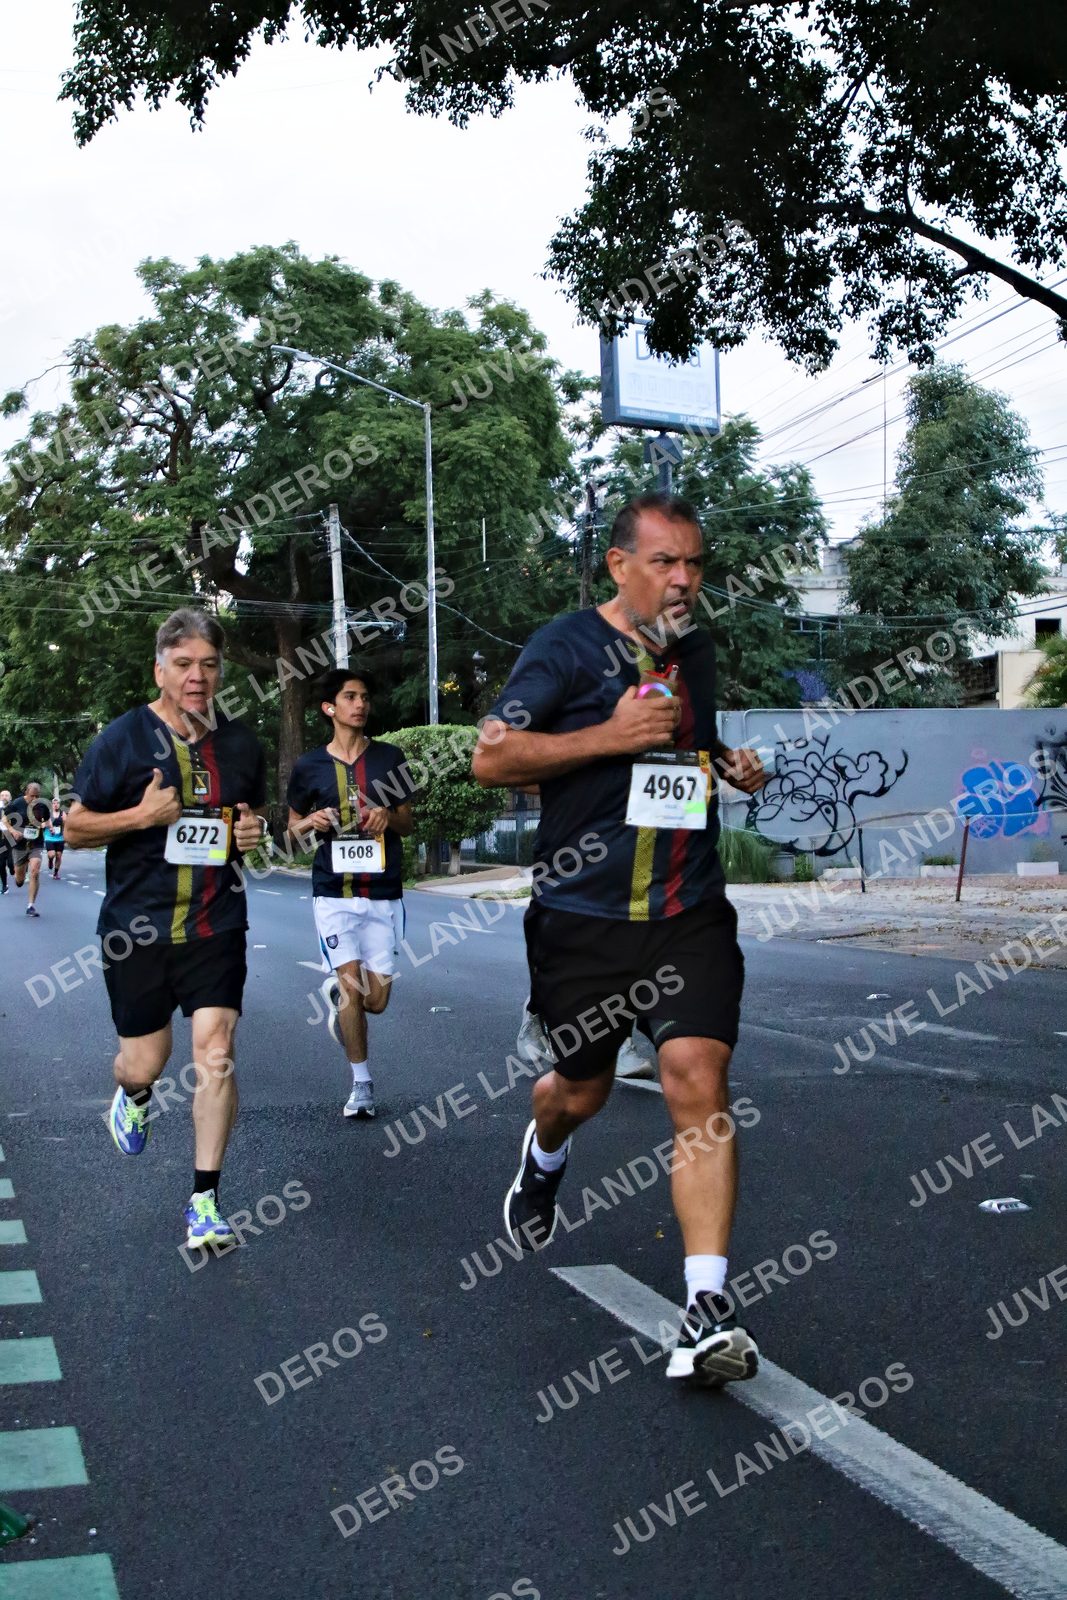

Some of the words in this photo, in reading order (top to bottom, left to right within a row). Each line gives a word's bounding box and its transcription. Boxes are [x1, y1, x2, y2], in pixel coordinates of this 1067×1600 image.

[643, 774, 697, 801] 4967
[176, 825, 219, 845] 6272
[339, 845, 374, 859] 1608
